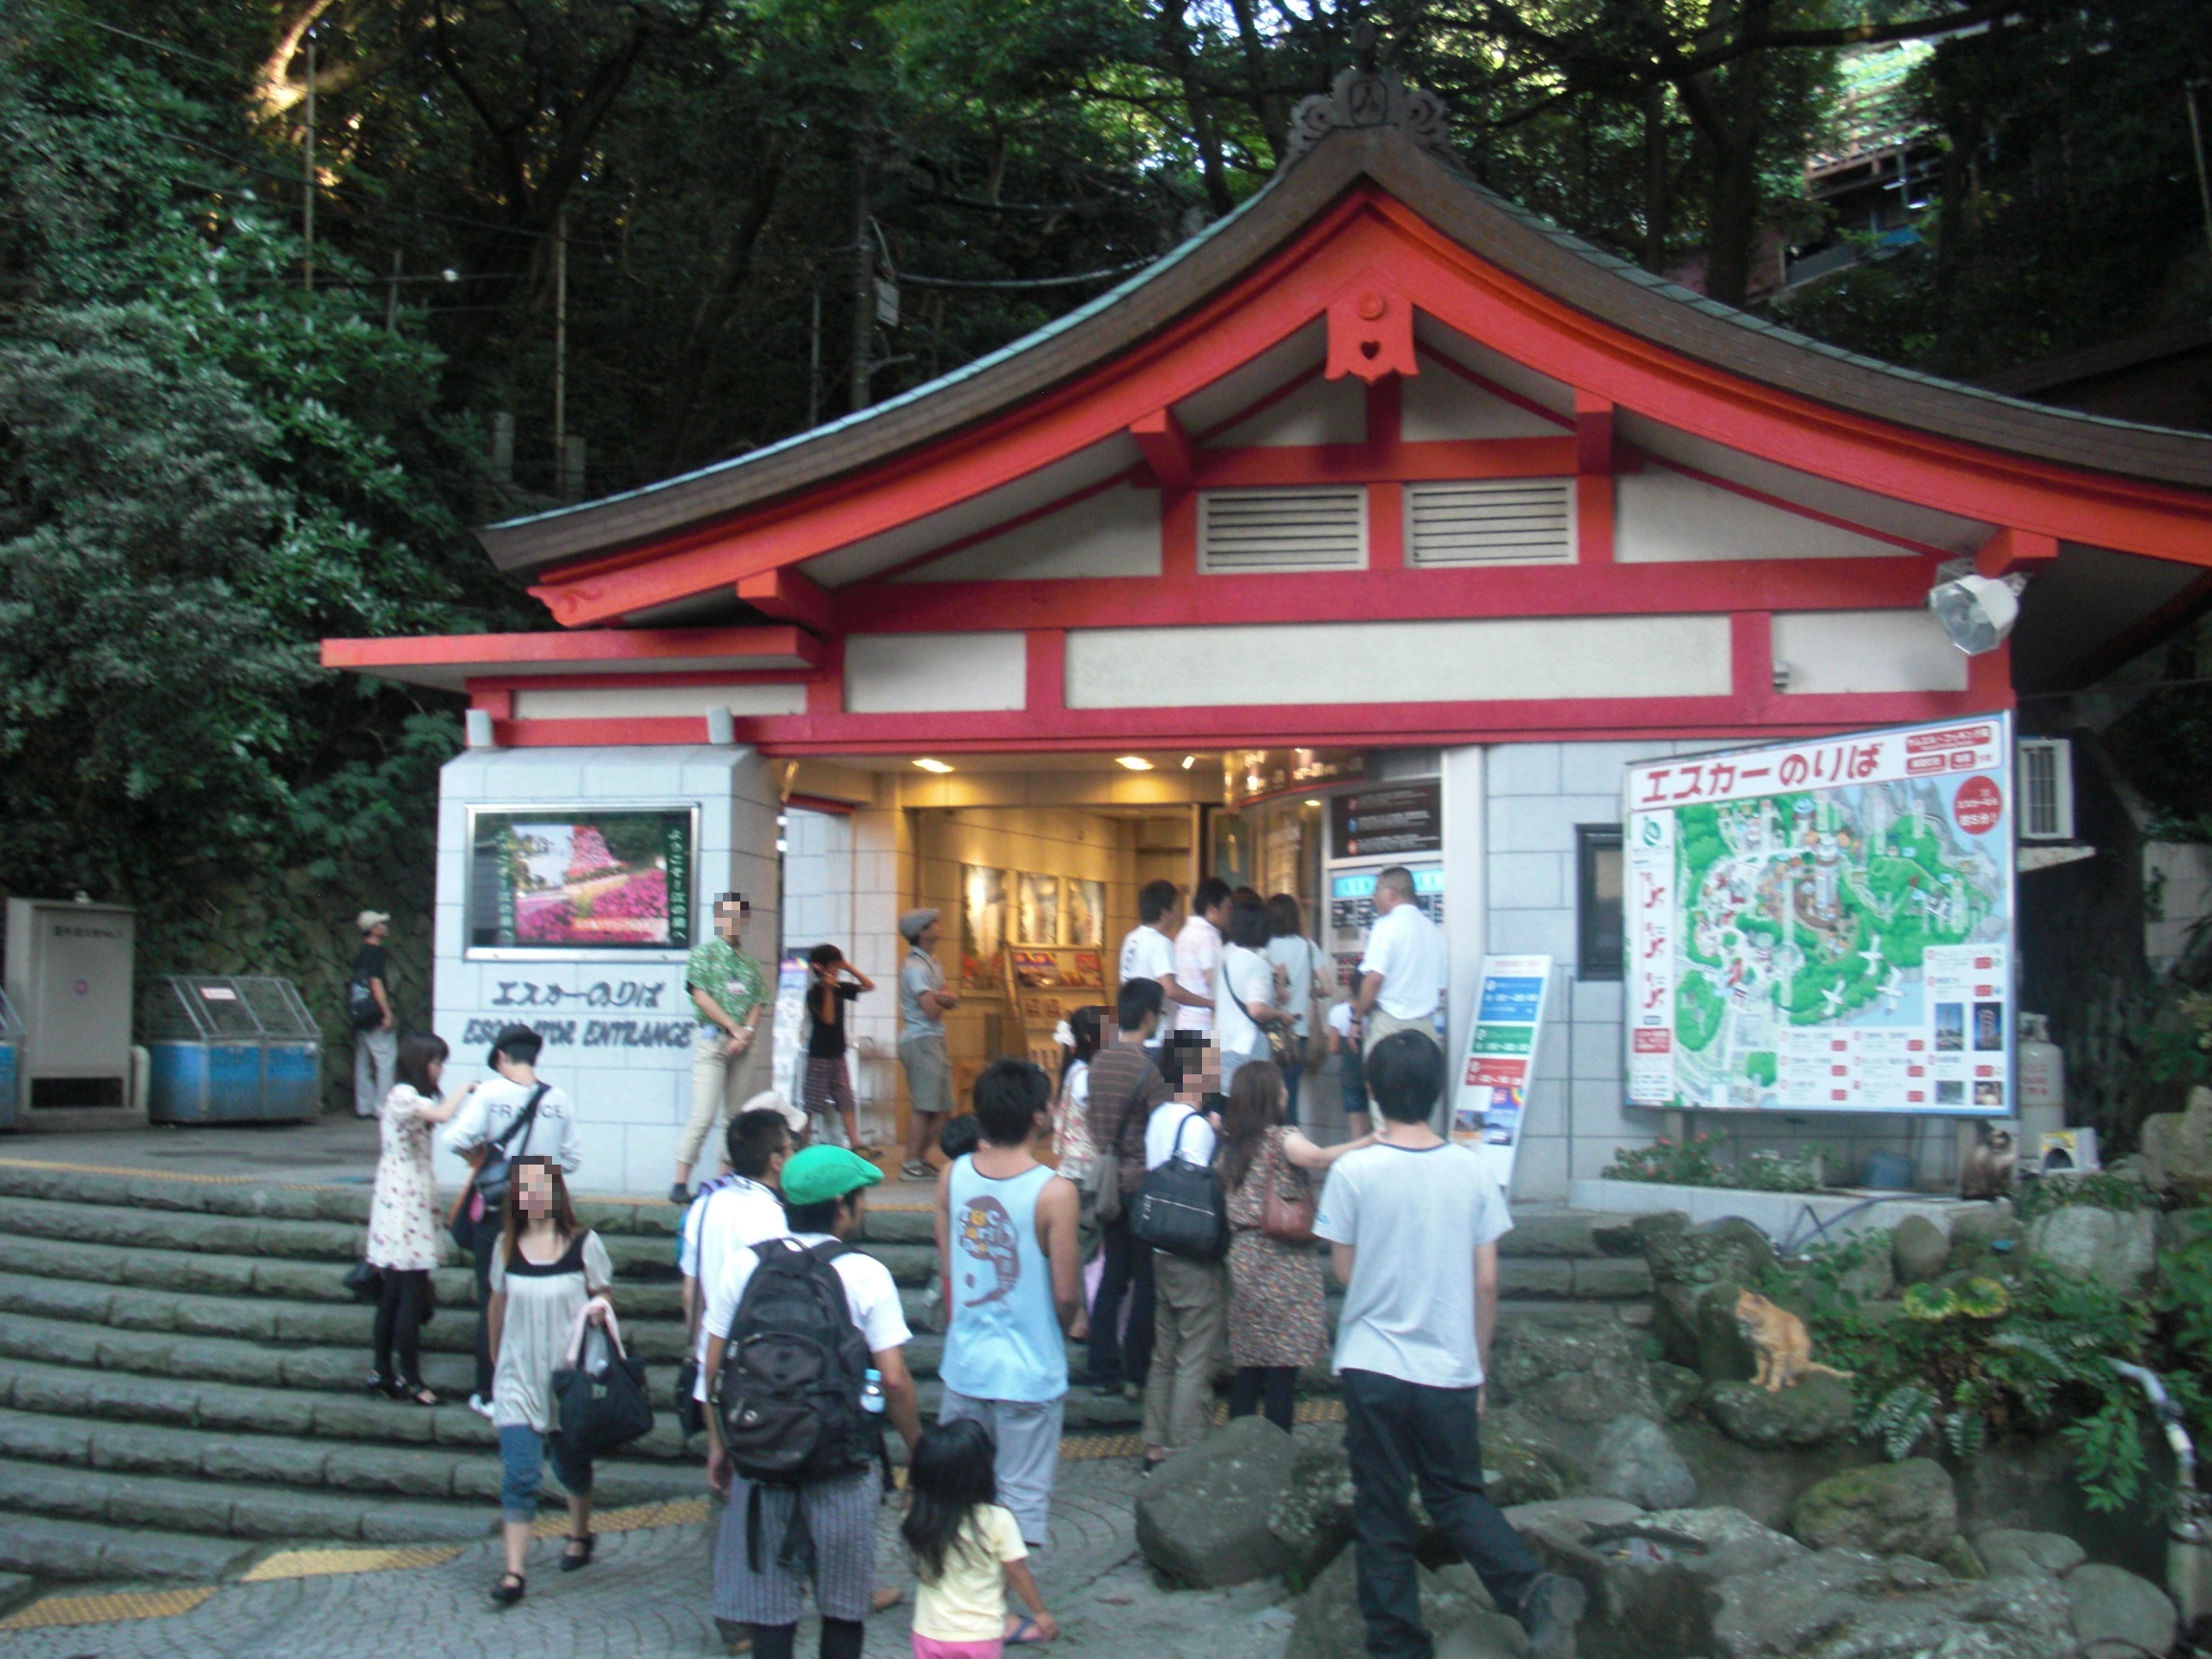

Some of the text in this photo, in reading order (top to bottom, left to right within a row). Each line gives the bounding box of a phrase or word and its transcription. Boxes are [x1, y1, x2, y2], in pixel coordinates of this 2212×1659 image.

[1642, 743, 1884, 803] エスカーのりば
[492, 981, 666, 1008] エスカーのりば
[462, 1019, 695, 1047] ESCTOR ENTRANCE
[490, 1103, 565, 1119] FRCE
